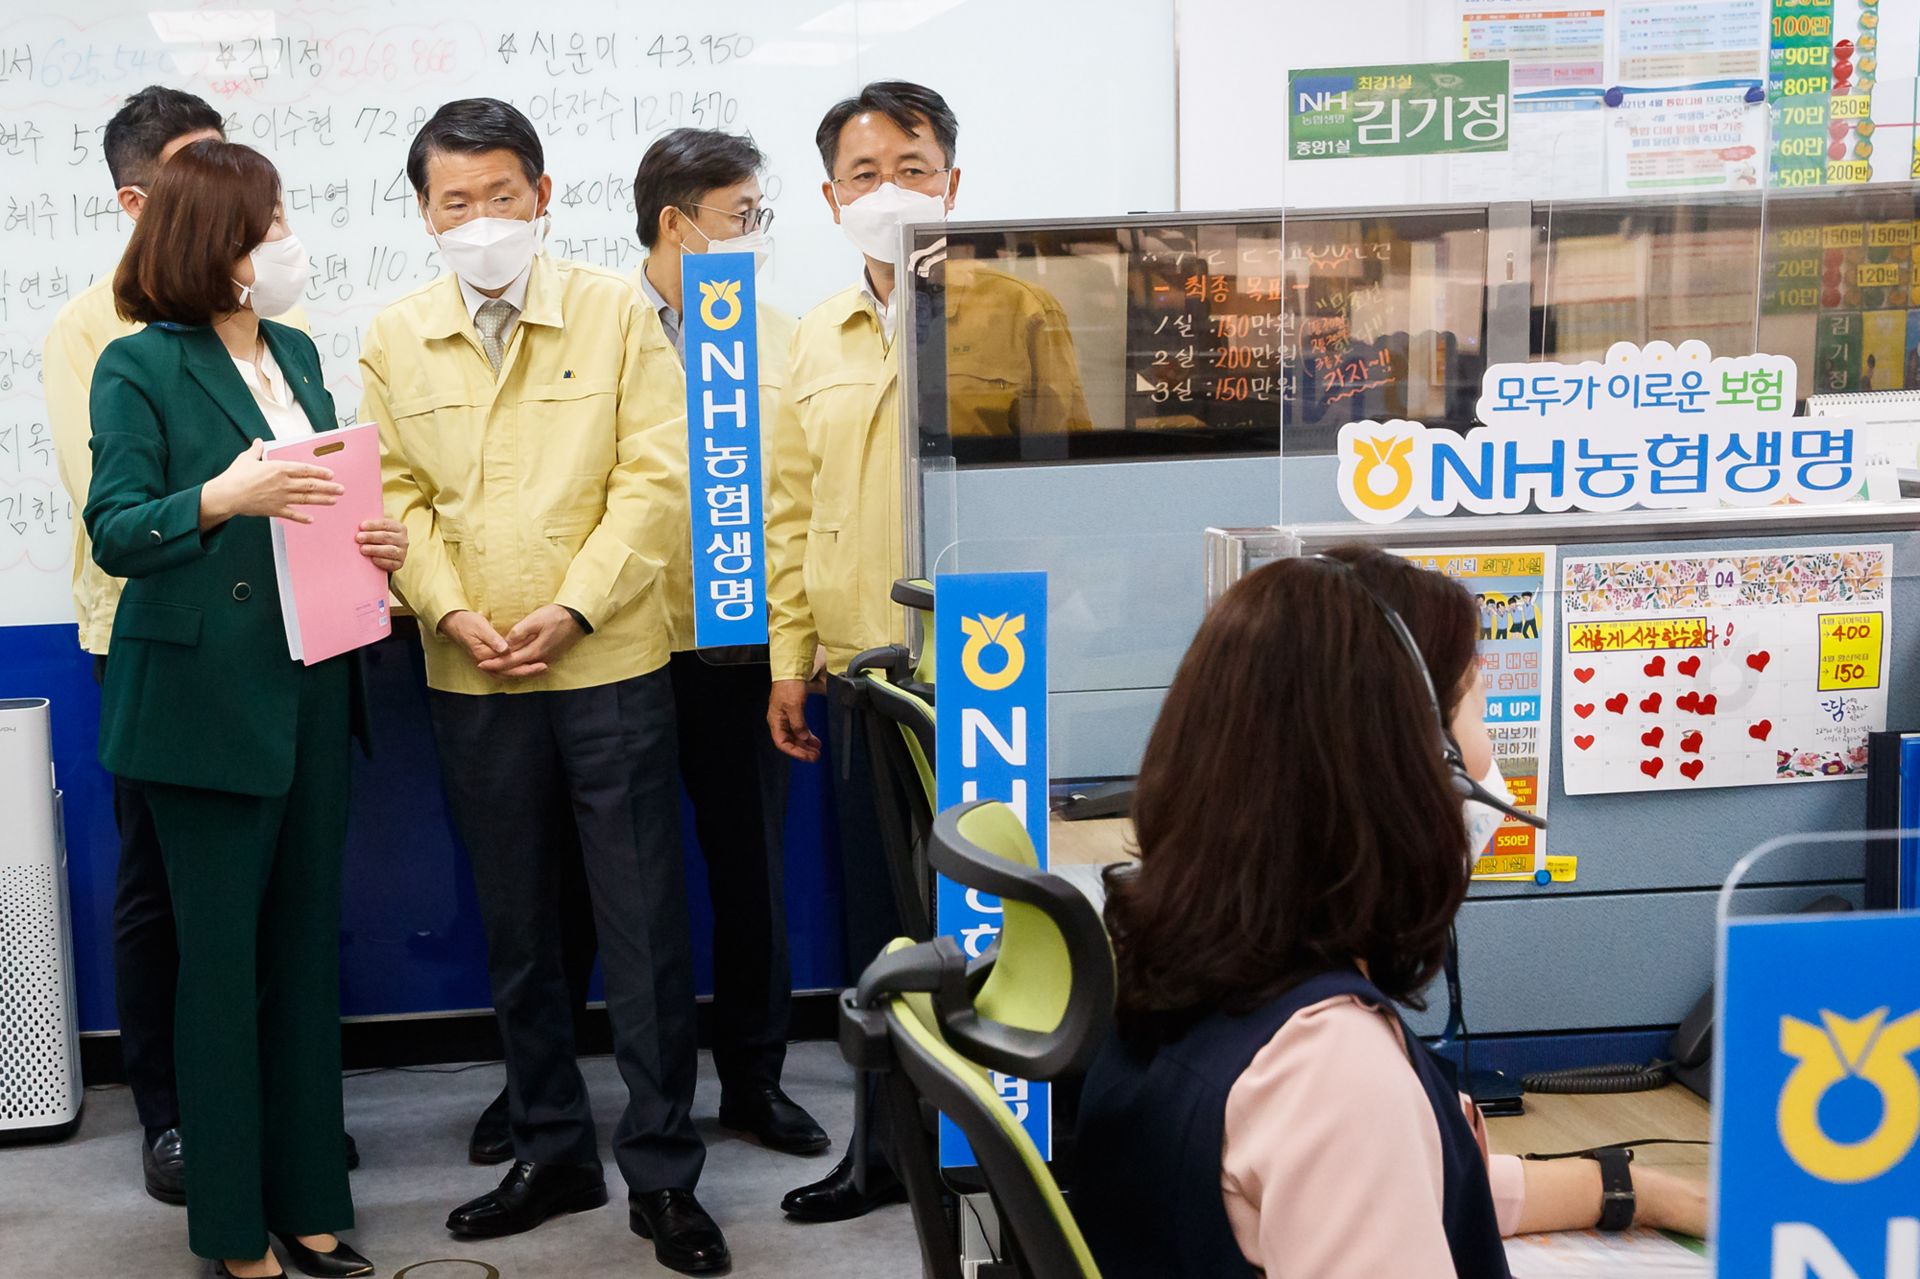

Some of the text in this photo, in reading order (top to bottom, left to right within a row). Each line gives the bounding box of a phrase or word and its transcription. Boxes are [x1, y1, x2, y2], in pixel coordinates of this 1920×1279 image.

[1772, 16, 1831, 36] 100만
[242, 36, 322, 80] 김기정
[530, 31, 618, 76] 신운미
[647, 33, 755, 69] 43.950
[1785, 46, 1829, 66] 90만
[1359, 75, 1412, 91] 최강1실
[1784, 76, 1828, 96] 80만
[1300, 91, 1347, 113] NH
[1831, 100, 1870, 116] 250만
[1353, 94, 1506, 144] 김기정
[1783, 106, 1825, 125] 70만
[253, 106, 335, 150] 이수현
[1297, 139, 1350, 156] 중앙1실
[1780, 137, 1824, 156] 60만
[1780, 168, 1822, 188] 50만
[1828, 164, 1868, 181] 200만
[287, 179, 349, 228] 다영
[4, 193, 58, 240] 혜주
[1780, 228, 1819, 247] 30만
[1871, 227, 1909, 243] 150만
[1778, 259, 1818, 277] 20만
[1858, 267, 1899, 284] 120만
[1185, 274, 1288, 303] 최종 목표
[1779, 288, 1818, 306] 10만
[1154, 314, 1194, 337] 1실
[1152, 345, 1195, 368] 2실
[1151, 378, 1194, 402] 3실
[1492, 367, 1784, 417] 모두가 이로운 보험
[1431, 427, 1855, 501] NH농협생명
[701, 341, 755, 621] NH농협생명
[1446, 558, 1477, 576] 신뢰
[1483, 558, 1514, 575] 최강
[1518, 557, 1541, 575] 1실
[1715, 571, 1734, 588] 04
[1832, 625, 1871, 642] 400
[1834, 664, 1865, 682] 150
[1484, 702, 1536, 717] 여 UP!
[1493, 742, 1536, 755] 뢰하기!
[1497, 834, 1529, 847] 550만
